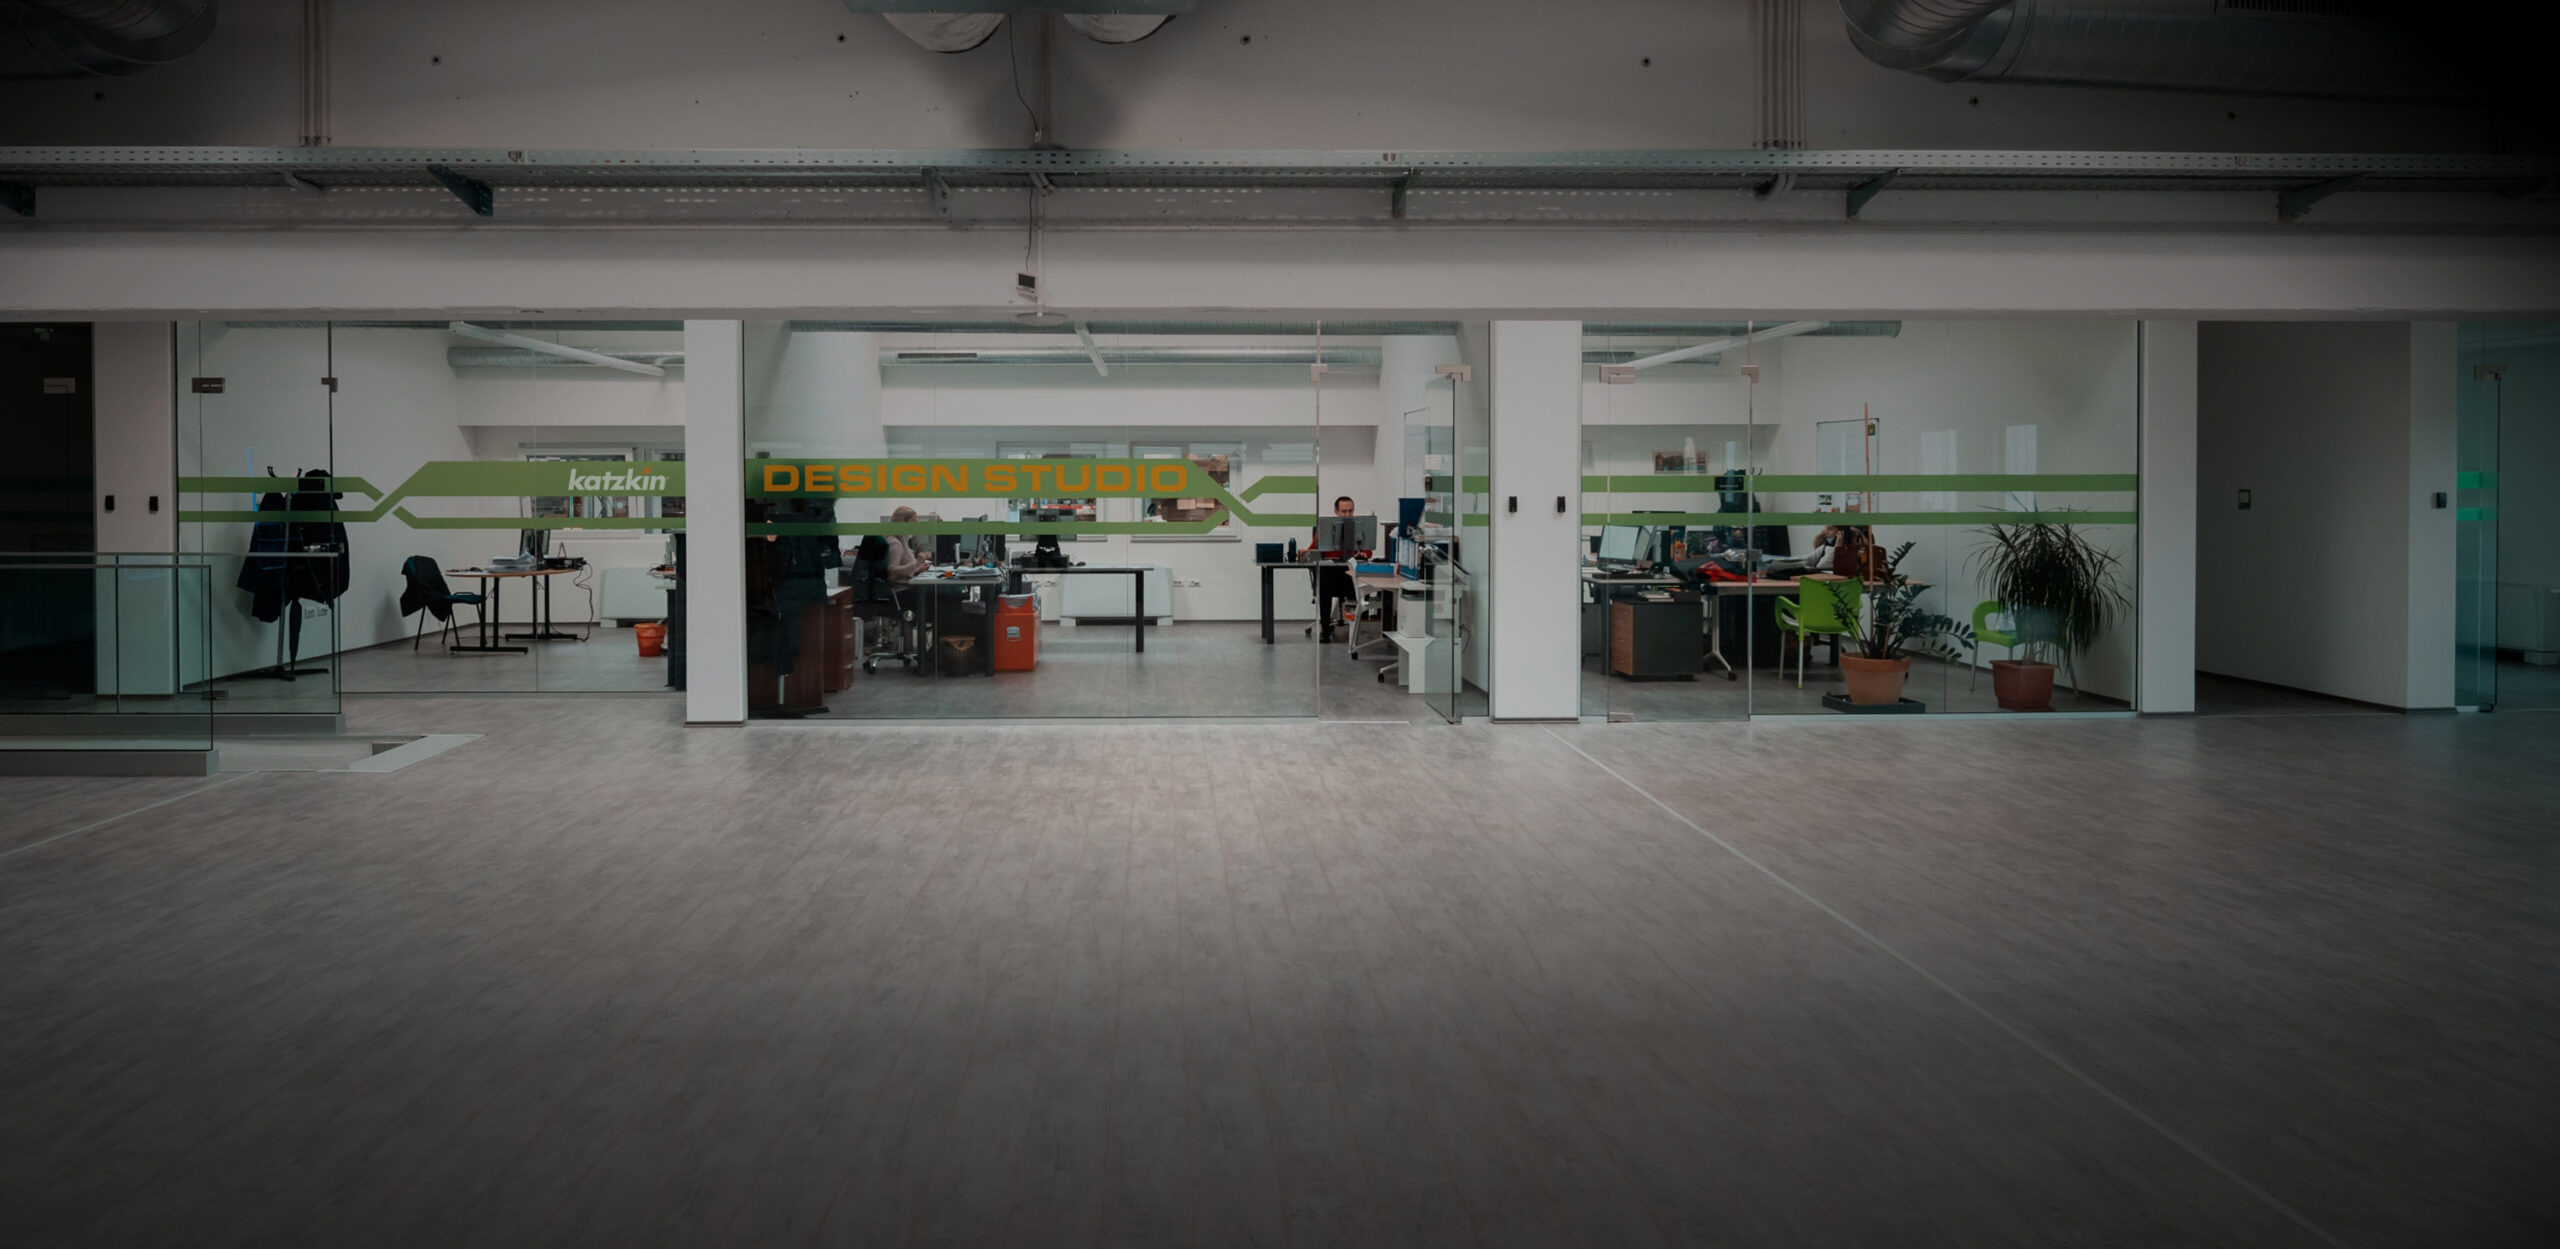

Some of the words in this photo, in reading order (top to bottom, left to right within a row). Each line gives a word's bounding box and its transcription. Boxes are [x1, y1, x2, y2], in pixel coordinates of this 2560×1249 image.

[568, 465, 666, 491] katzkin
[763, 464, 968, 492] DESIGN
[984, 464, 1187, 492] STUDIO
